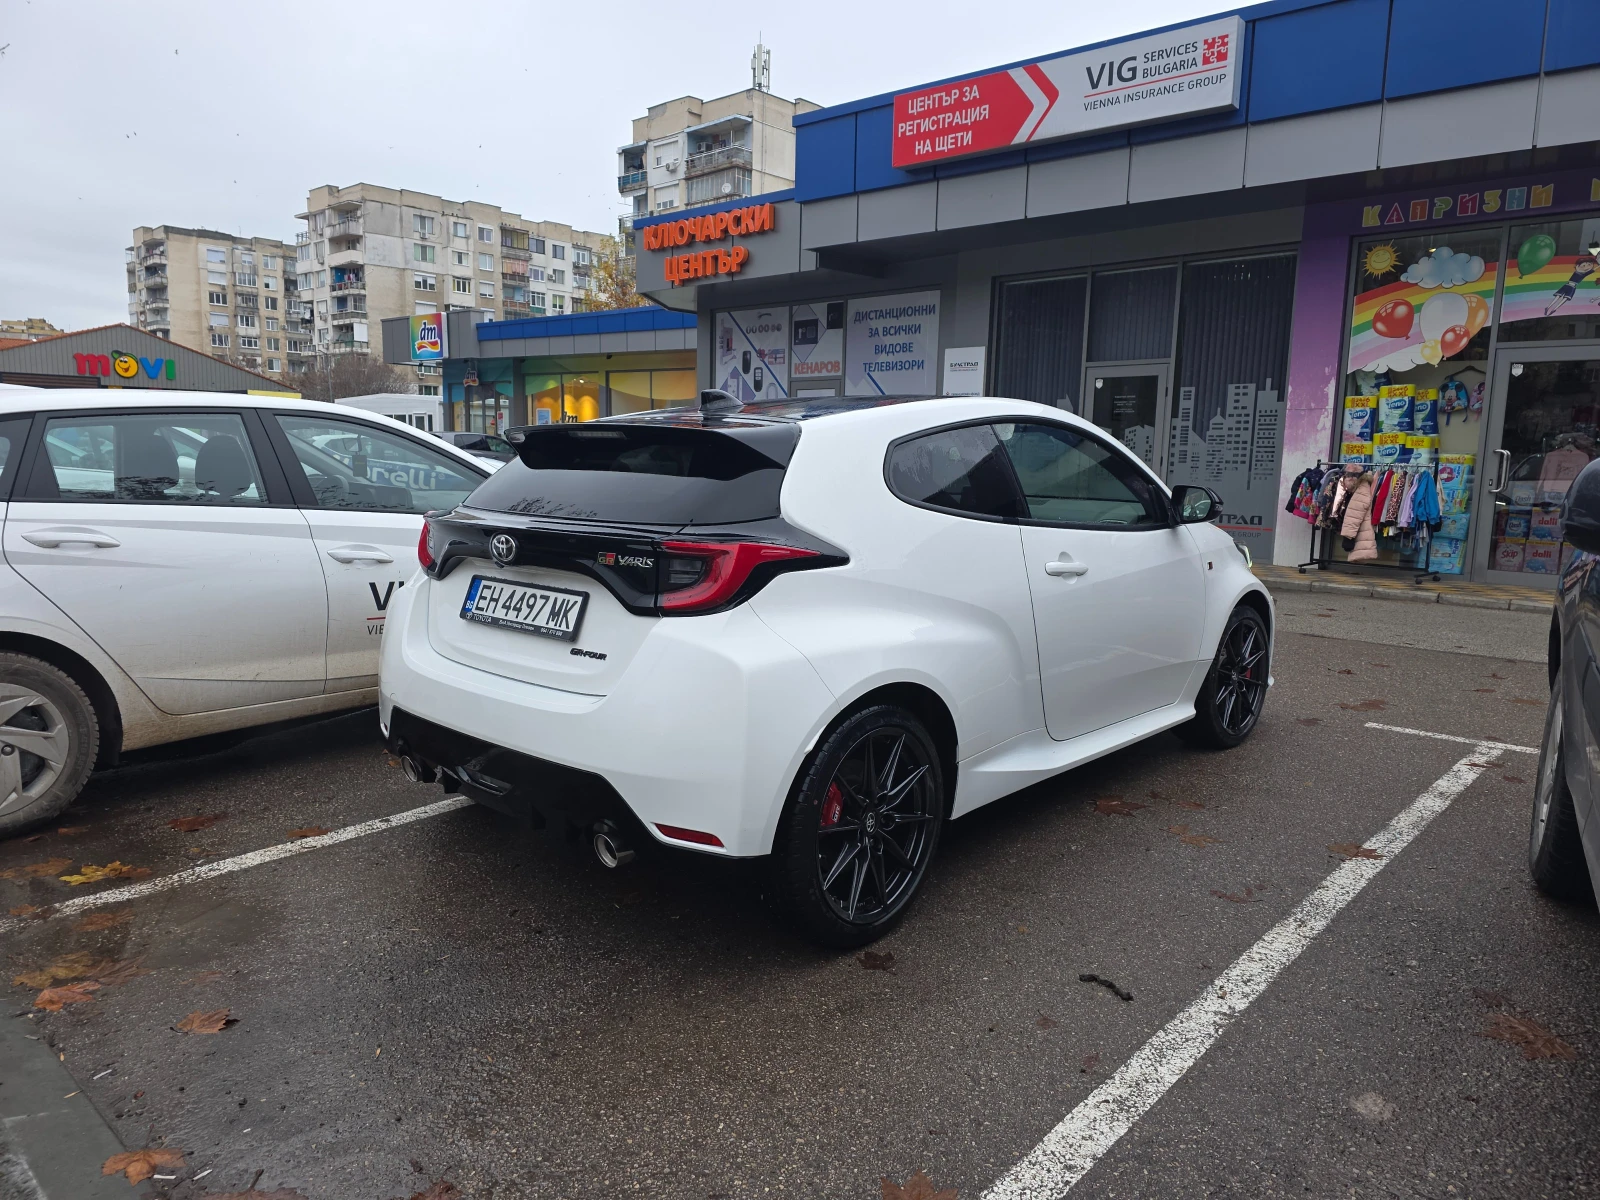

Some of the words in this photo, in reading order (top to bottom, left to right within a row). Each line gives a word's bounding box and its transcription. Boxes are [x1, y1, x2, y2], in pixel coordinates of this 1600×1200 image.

[1143, 41, 1198, 64] SERVICES
[1086, 56, 1137, 90] VIG
[1142, 57, 1198, 79] BULGARIA
[908, 89, 959, 115] ЦЕНТЪР
[962, 84, 979, 101] ЗА
[1083, 96, 1121, 112] VIENNA
[1123, 82, 1185, 104] INSURANCE
[1187, 73, 1227, 90] GROUP
[898, 104, 989, 138] РЕГИСТРАЦИЯ
[915, 139, 932, 156] НА
[935, 130, 972, 153] ЩЕТИ
[1362, 183, 1554, 228] КАПРИЗНИ
[643, 202, 775, 251] КЛЮЧАРСКИ
[664, 245, 749, 286] ЦЕНТЪР
[854, 303, 936, 324] ДИСТАНЦИОННИ
[420, 320, 437, 341] dm
[868, 326, 880, 338] ЗА
[882, 322, 922, 337] ВСИЧКИ
[874, 341, 914, 356] ВИДОВЕ
[794, 360, 841, 375] КЕНАРОВ
[862, 358, 925, 373] ТЕЛЕВИЗОРИ
[1538, 517, 1557, 526] dalli
[1501, 549, 1518, 559] Skip
[1532, 550, 1552, 558] dalli
[501, 589, 550, 622] 4497
